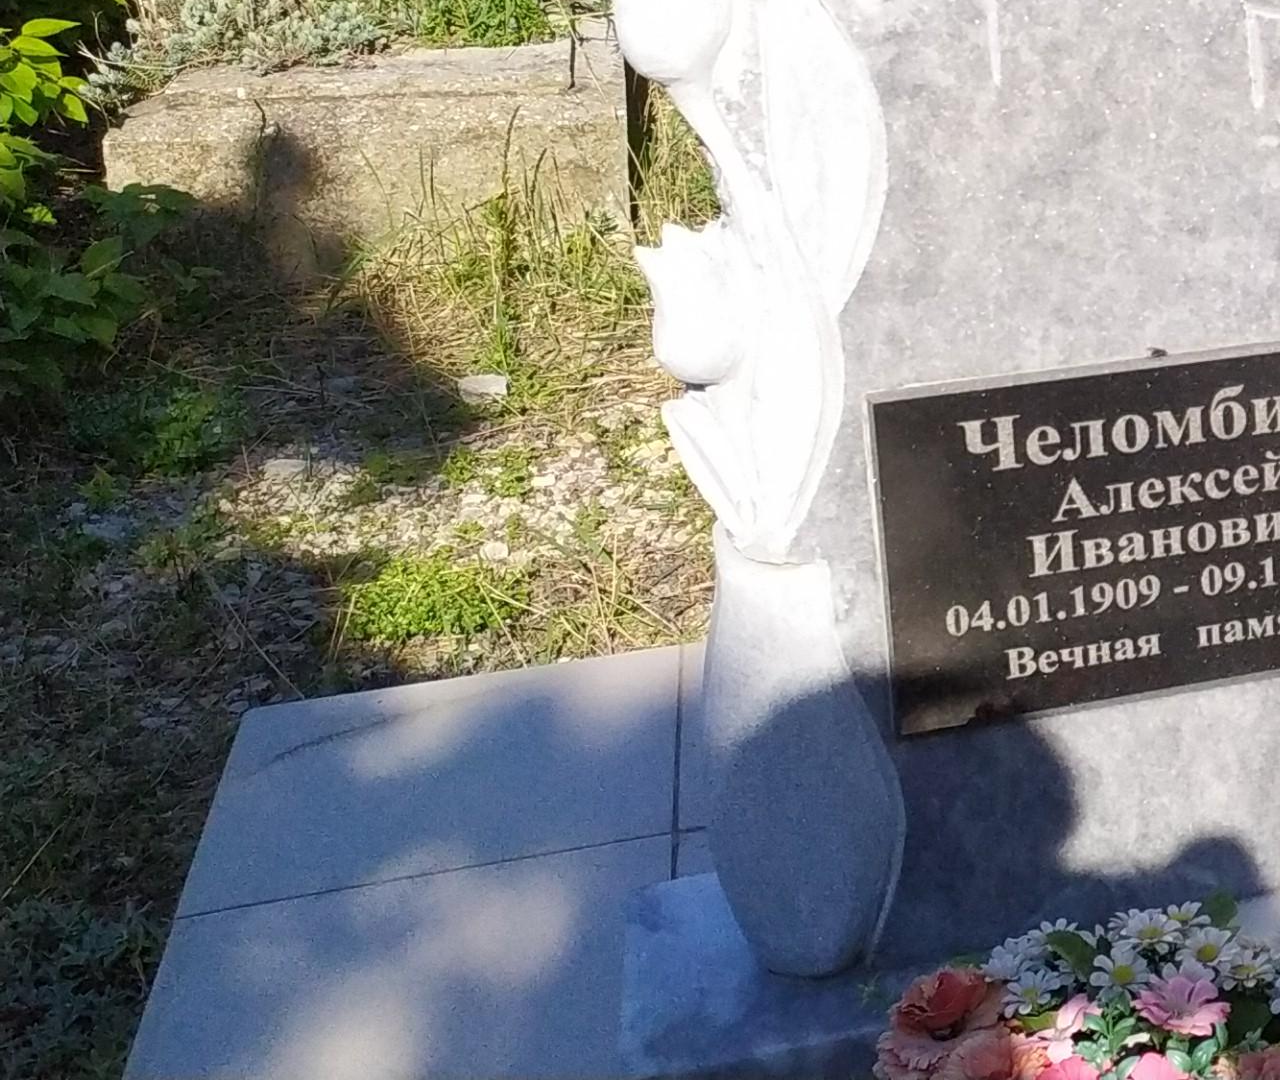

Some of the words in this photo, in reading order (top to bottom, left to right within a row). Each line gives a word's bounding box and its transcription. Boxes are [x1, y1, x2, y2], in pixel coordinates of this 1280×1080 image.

[945, 574, 1161, 638] 04.01.1909
[1173, 584, 1189, 594] -
[1004, 634, 1162, 680] Вечная
